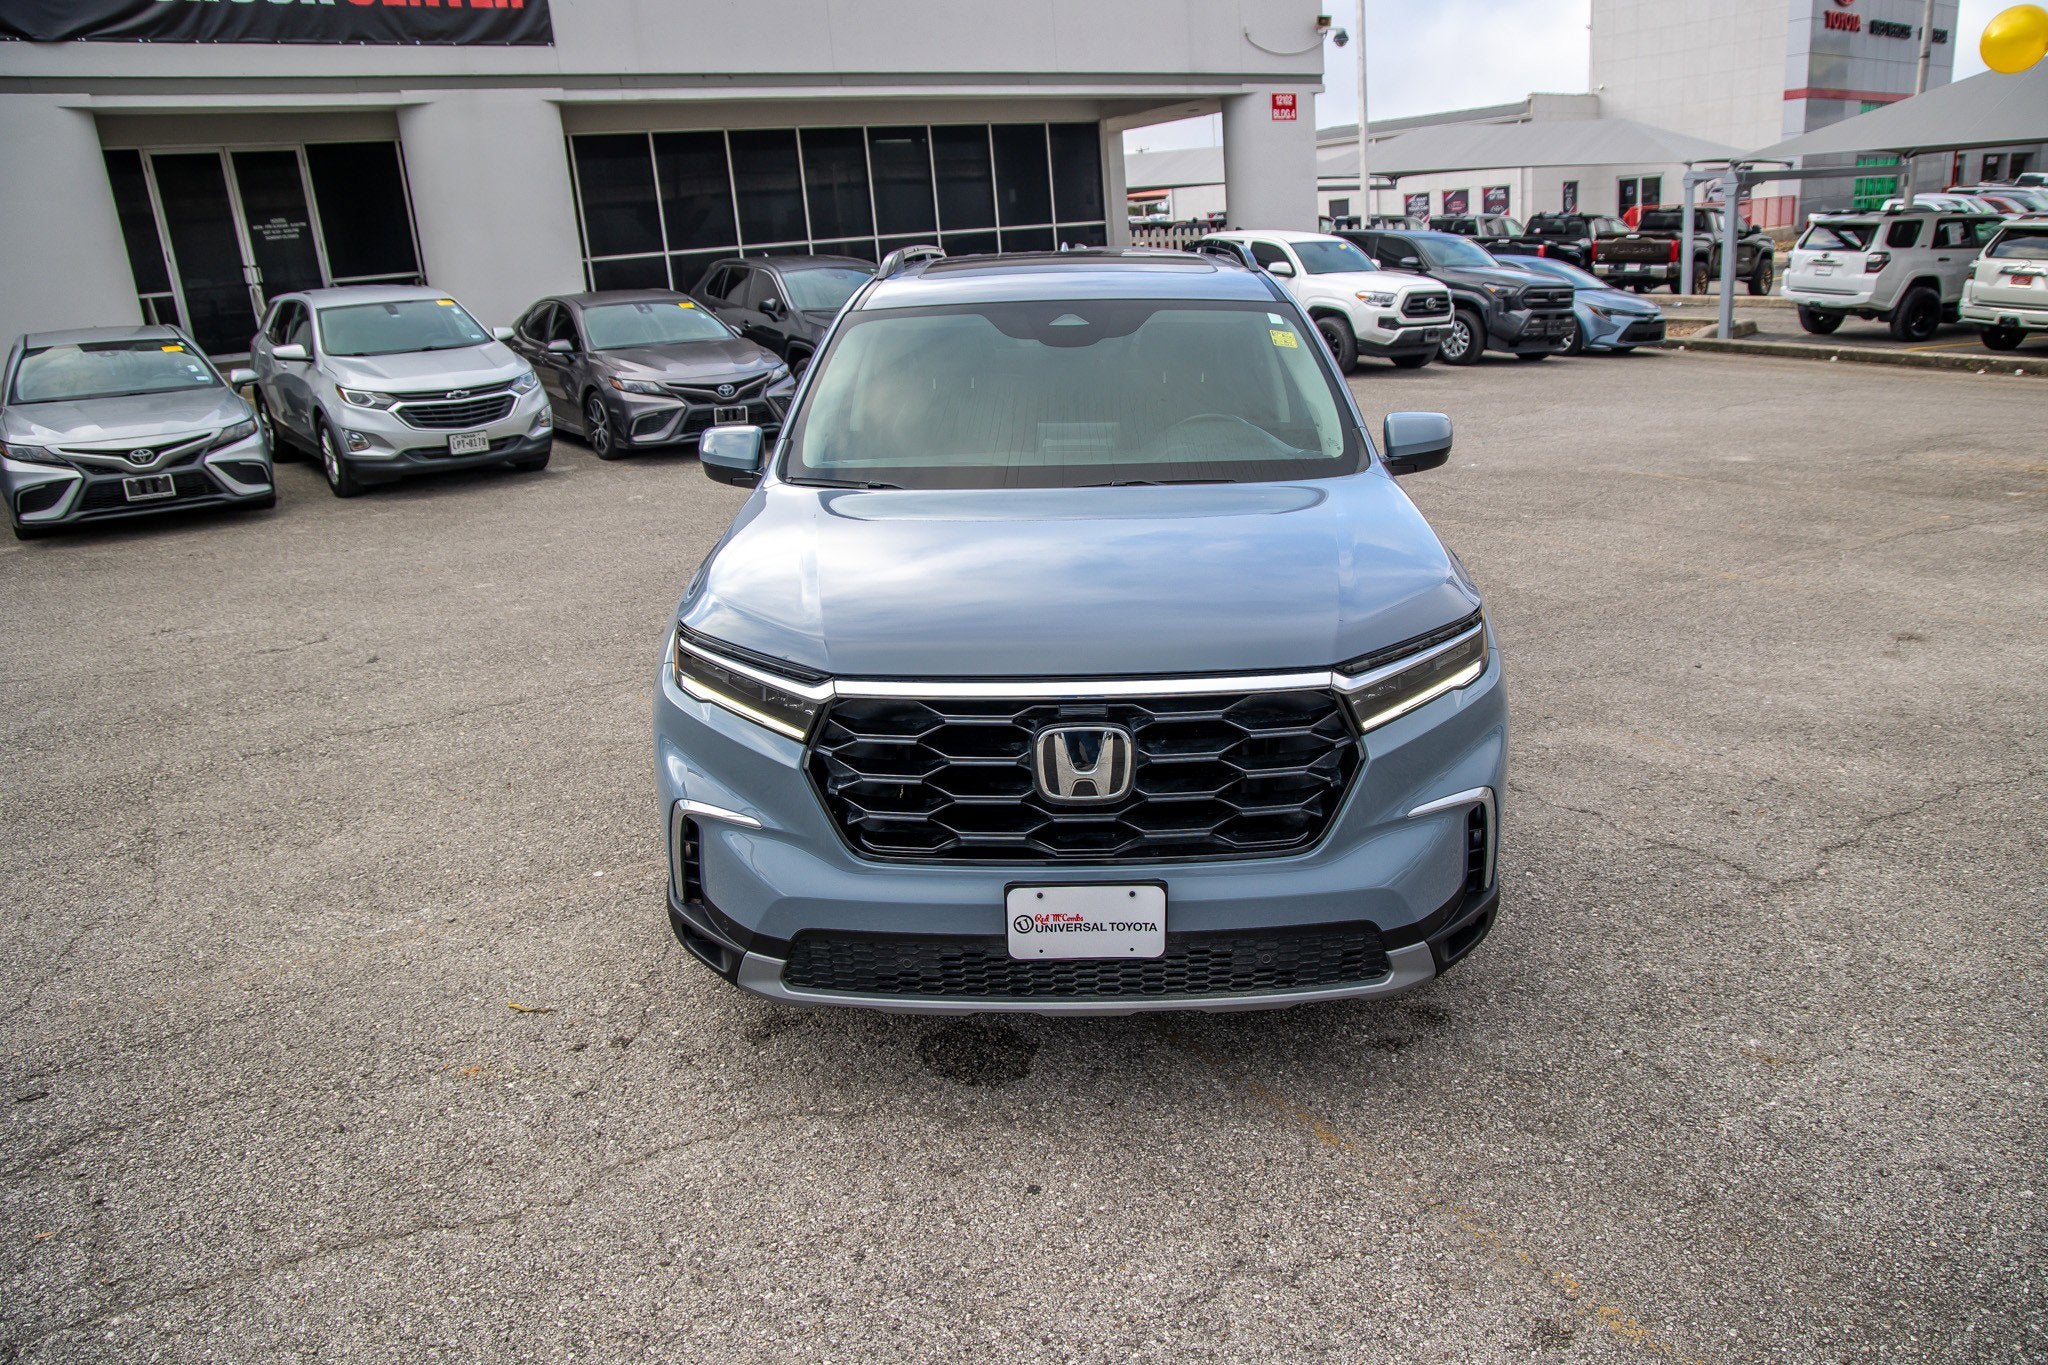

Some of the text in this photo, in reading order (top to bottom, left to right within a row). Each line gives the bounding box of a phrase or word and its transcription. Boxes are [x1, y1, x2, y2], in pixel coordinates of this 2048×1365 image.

[1824, 10, 1861, 32] TOYOTA
[1035, 922, 1158, 933] UNIVERSAL TOYOTA
